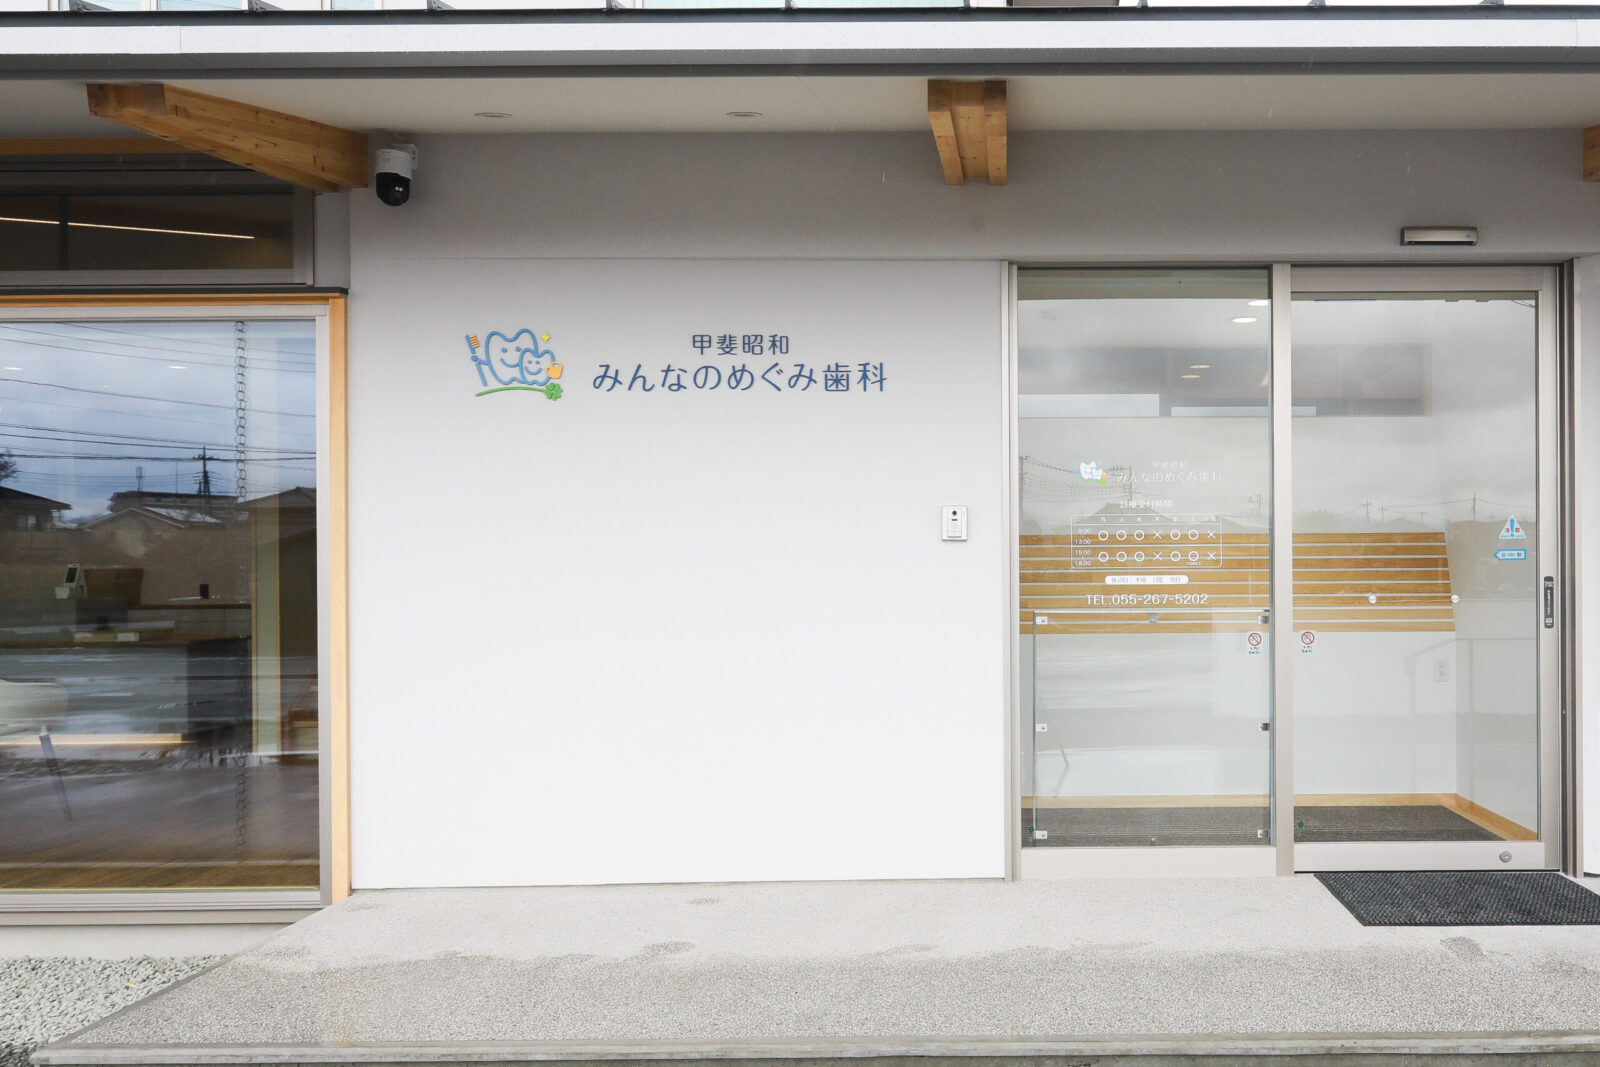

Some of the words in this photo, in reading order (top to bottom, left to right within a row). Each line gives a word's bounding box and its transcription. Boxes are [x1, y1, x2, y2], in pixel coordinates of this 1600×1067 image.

[692, 334, 789, 355] 甲斐昭和
[592, 362, 888, 392] みんなのめぐみ歯科
[1117, 471, 1223, 483] みんなのめぐみ歯科
[1086, 593, 1208, 605] TEL.055-267-5202
